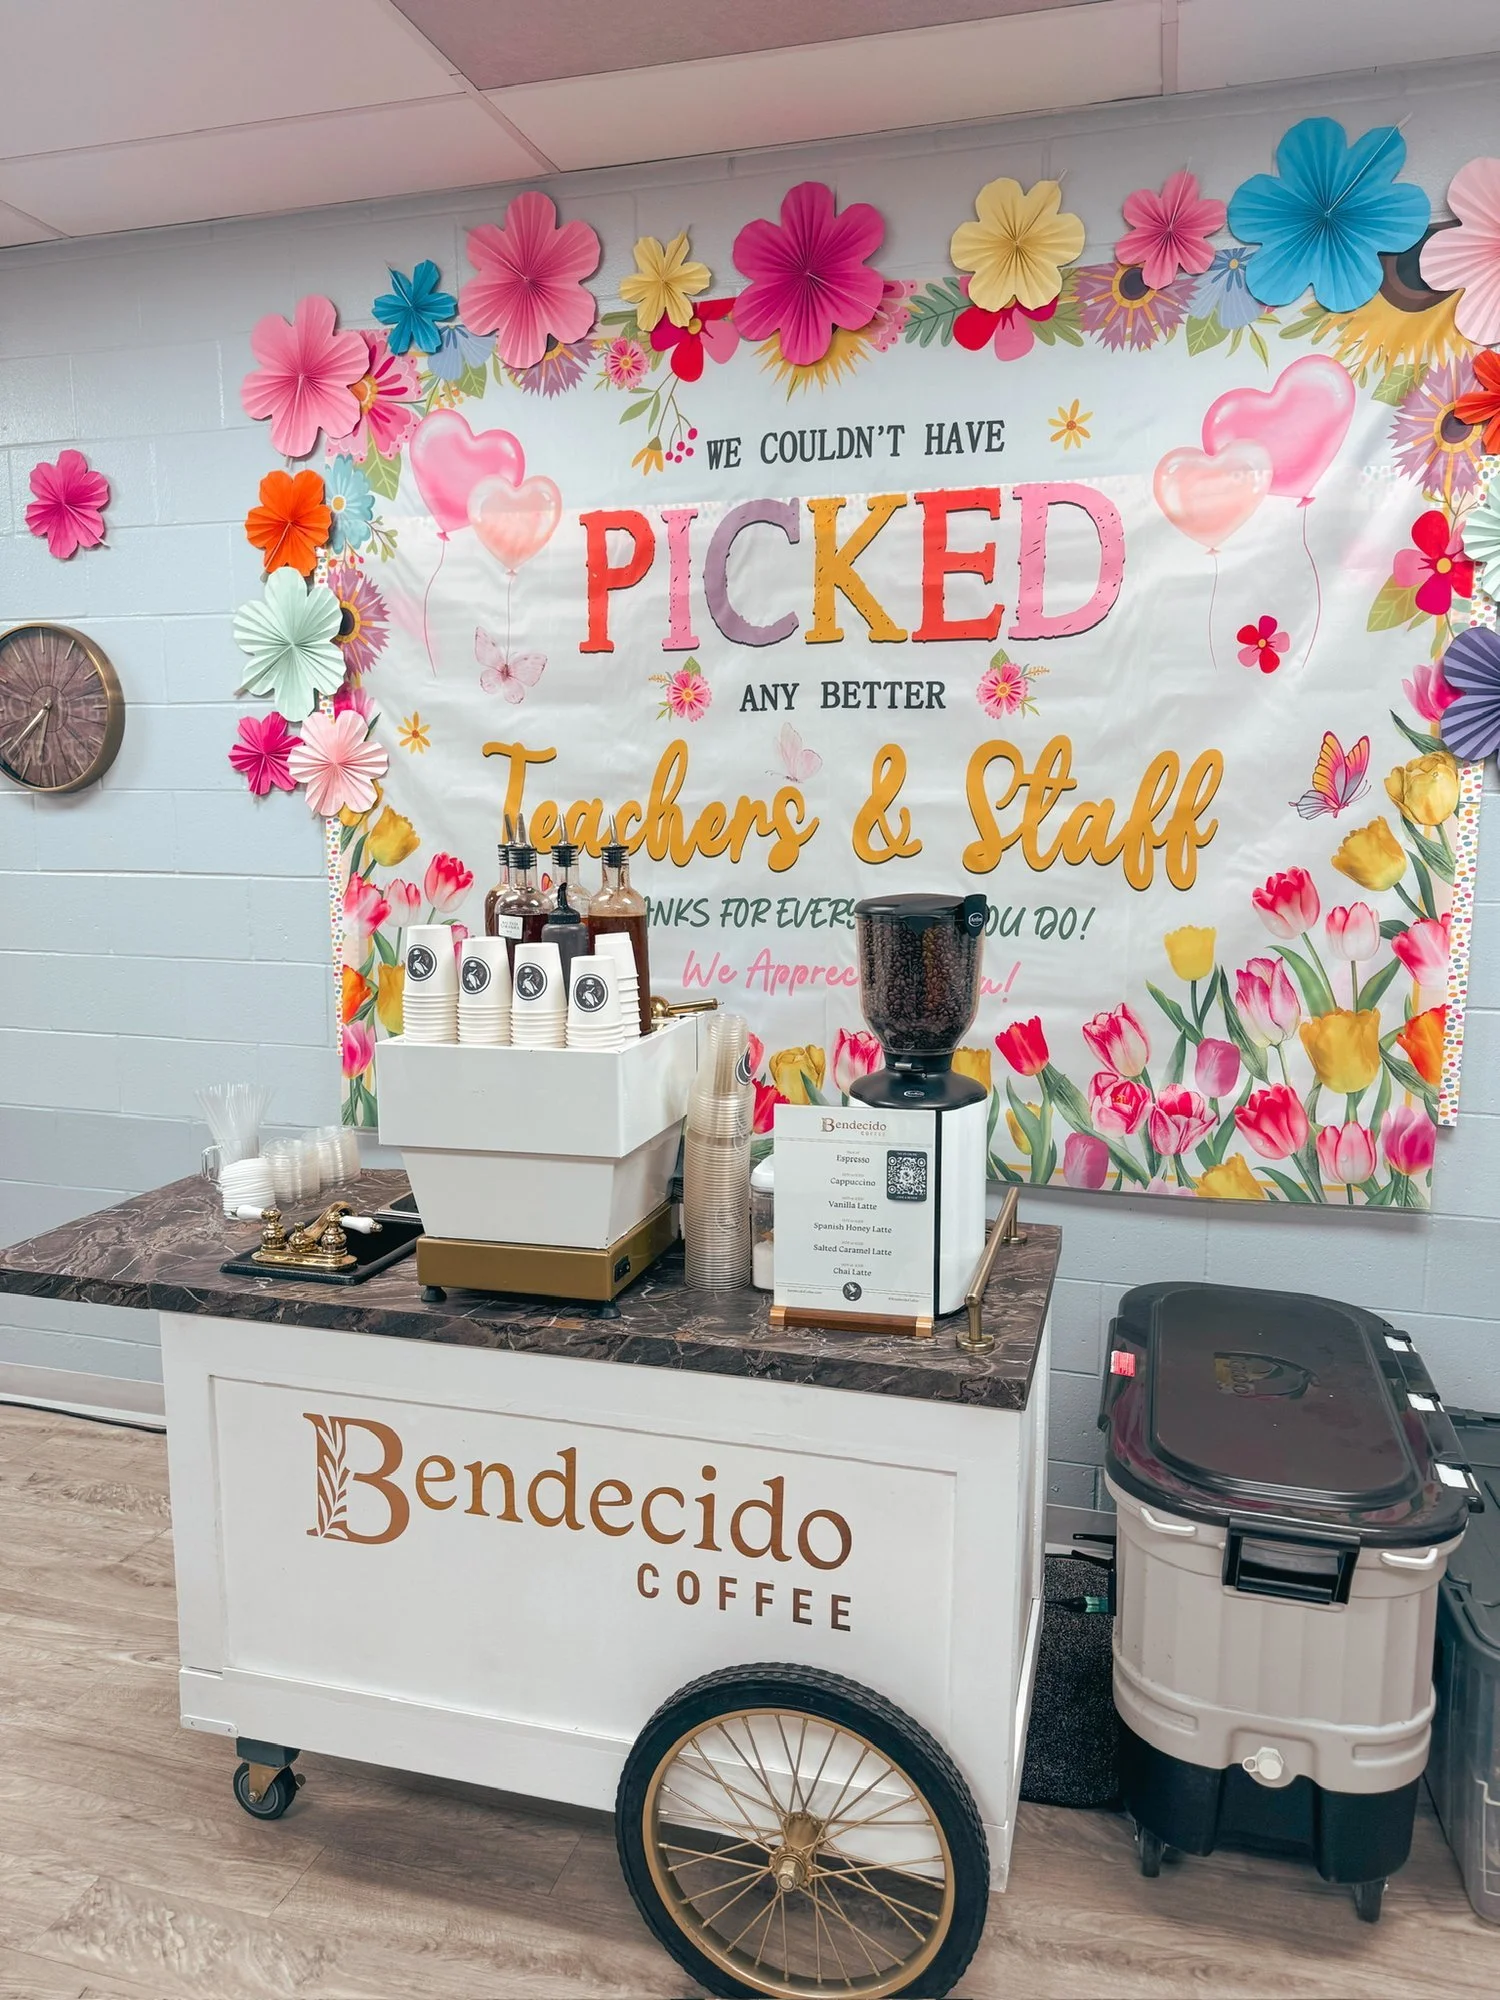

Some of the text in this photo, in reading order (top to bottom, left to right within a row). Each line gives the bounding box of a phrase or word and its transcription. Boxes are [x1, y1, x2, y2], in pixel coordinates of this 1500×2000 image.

[707, 420, 1006, 471] WE COULDN'T HAVE
[579, 482, 1126, 655] PICKED
[740, 680, 946, 712] ANY BETTER
[482, 734, 1225, 893] Teachers & Staff
[720, 897, 772, 929] FOR
[984, 905, 1027, 938] OU
[1033, 906, 1096, 940] DO!
[682, 949, 738, 988] We
[745, 948, 860, 997] Apprec
[821, 1117, 887, 1132] Bendecido
[836, 1154, 870, 1164] Espresso
[830, 1177, 876, 1187] Cappuccino
[828, 1200, 878, 1210] Vanilla Latte
[813, 1222, 892, 1234] Spanish Honey Latte
[813, 1244, 892, 1256] Salted Caramel Latte
[833, 1267, 872, 1276] Chai Latte
[302, 1412, 853, 1571] Bendecido
[637, 1562, 853, 1632] COFFEE
